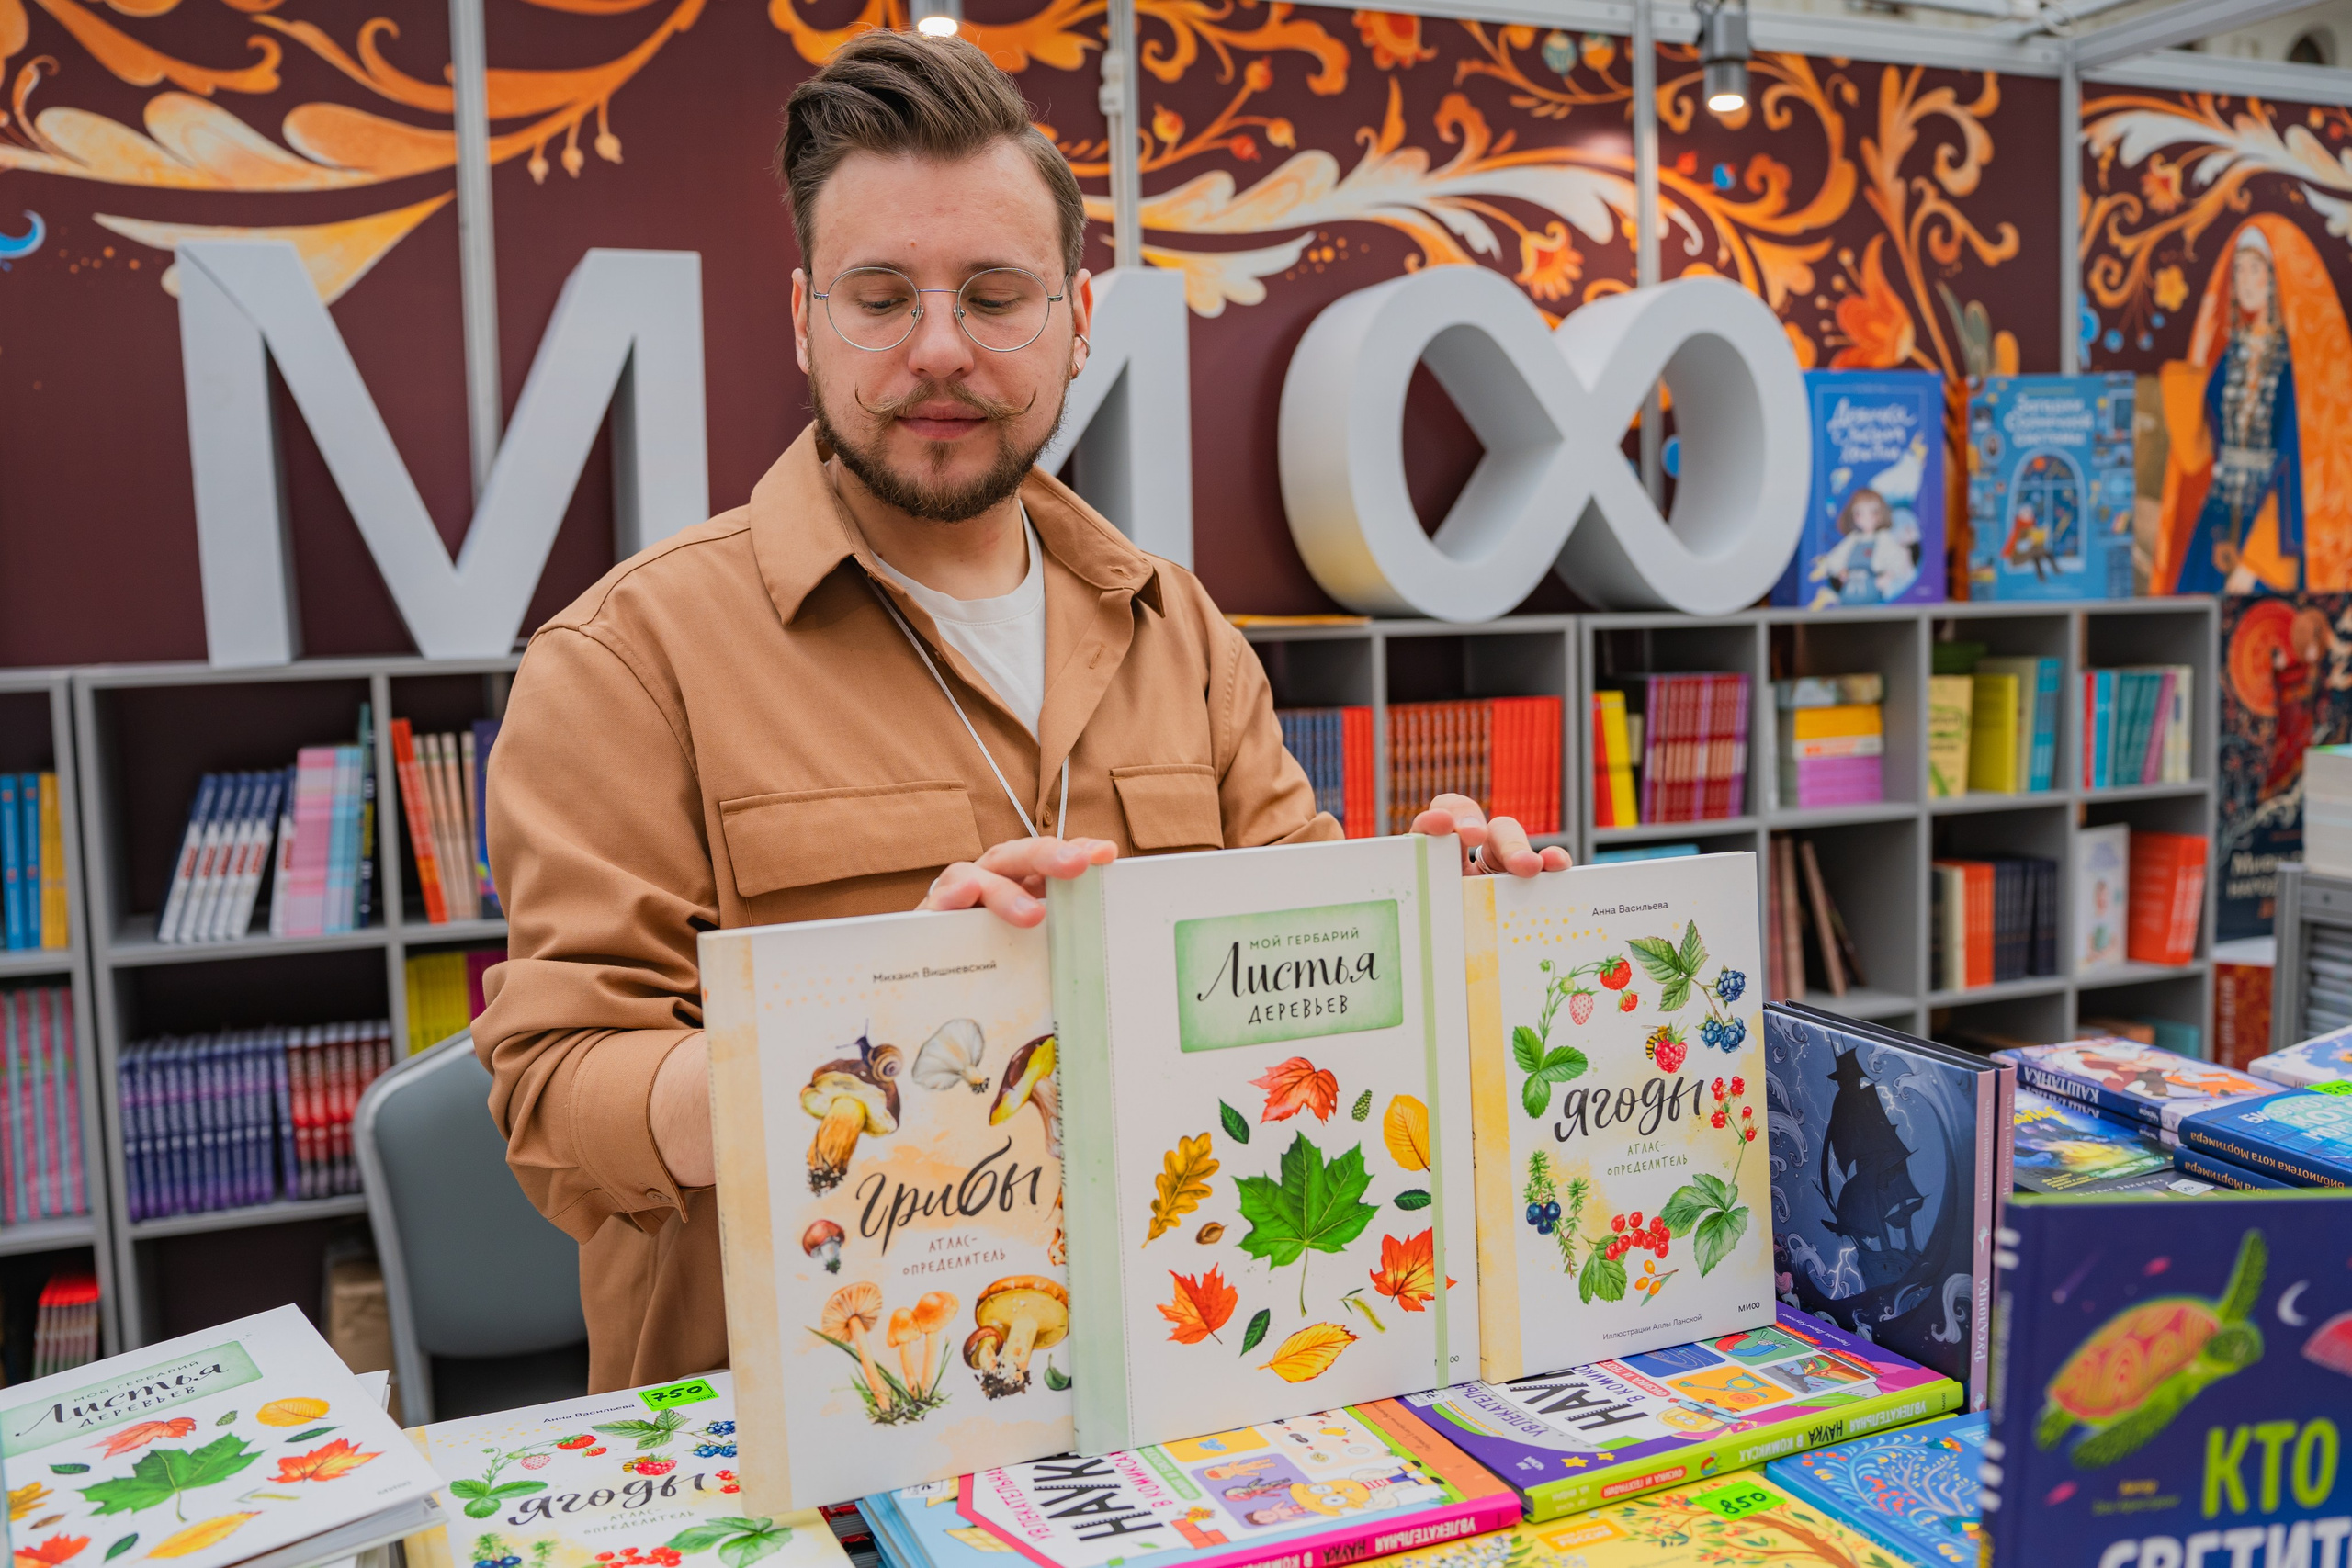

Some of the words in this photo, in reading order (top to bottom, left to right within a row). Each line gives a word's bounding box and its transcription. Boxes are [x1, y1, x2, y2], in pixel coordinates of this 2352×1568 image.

[1592, 906, 1616, 917] Анна
[1619, 900, 1669, 914] Васильева
[1250, 935, 1281, 950] МОЙ
[1287, 927, 1359, 946] ГЕРБАРИЙ
[872, 970, 919, 984] Михаил
[922, 961, 997, 977] Вишневский
[1197, 942, 1380, 1002] Листья
[1248, 994, 1348, 1025] ДЕРЕВЬЕВ
[2025, 1066, 2099, 1104] КАШТАНКА
[1627, 1142, 1666, 1156] АТЛАС-
[2190, 1131, 2249, 1160] Мортимера
[2251, 1151, 2277, 1168] кота
[1607, 1155, 1689, 1176] ОПРЕДЕЛИТЕЛЬ
[2185, 1160, 2243, 1190] Мортимера
[2278, 1161, 2346, 1190] Библиотека
[928, 1235, 978, 1253] АТЛАС-
[902, 1247, 1006, 1277] ОПРЕДЕЛИТЕЛЬ
[1602, 1325, 1651, 1341] Иллюстрации
[1652, 1321, 1671, 1331] Аллы
[1672, 1314, 1702, 1327] Ланской
[74, 1388, 110, 1403] МОЙ
[117, 1360, 199, 1390] ГЕРБАРИЙ
[651, 1385, 703, 1402] 750
[1571, 1364, 1634, 1398] КОМИКС
[15, 1363, 230, 1437] Листья
[78, 1386, 197, 1429] ДЕРЕВЬЕВ
[1453, 1382, 1549, 1438] УВЛЕКАТЕЛЬН
[1504, 1371, 1649, 1431] НАУ
[1627, 1393, 1646, 1404] В
[543, 1414, 572, 1424] Анна
[574, 1404, 635, 1417] Васильева
[1849, 1400, 1927, 1433] УВЛЕКАТЕЛЬНАЯ
[1807, 1419, 1844, 1448] НАУКА
[1739, 1435, 1794, 1463] КОМИКСАХ
[2202, 1416, 2340, 1519] КТО
[984, 1466, 1056, 1543] УВЛЕКАТЕЛЬНА
[1031, 1454, 1165, 1541] НАУК
[1151, 1499, 1174, 1510] В
[1719, 1491, 1767, 1516] 850
